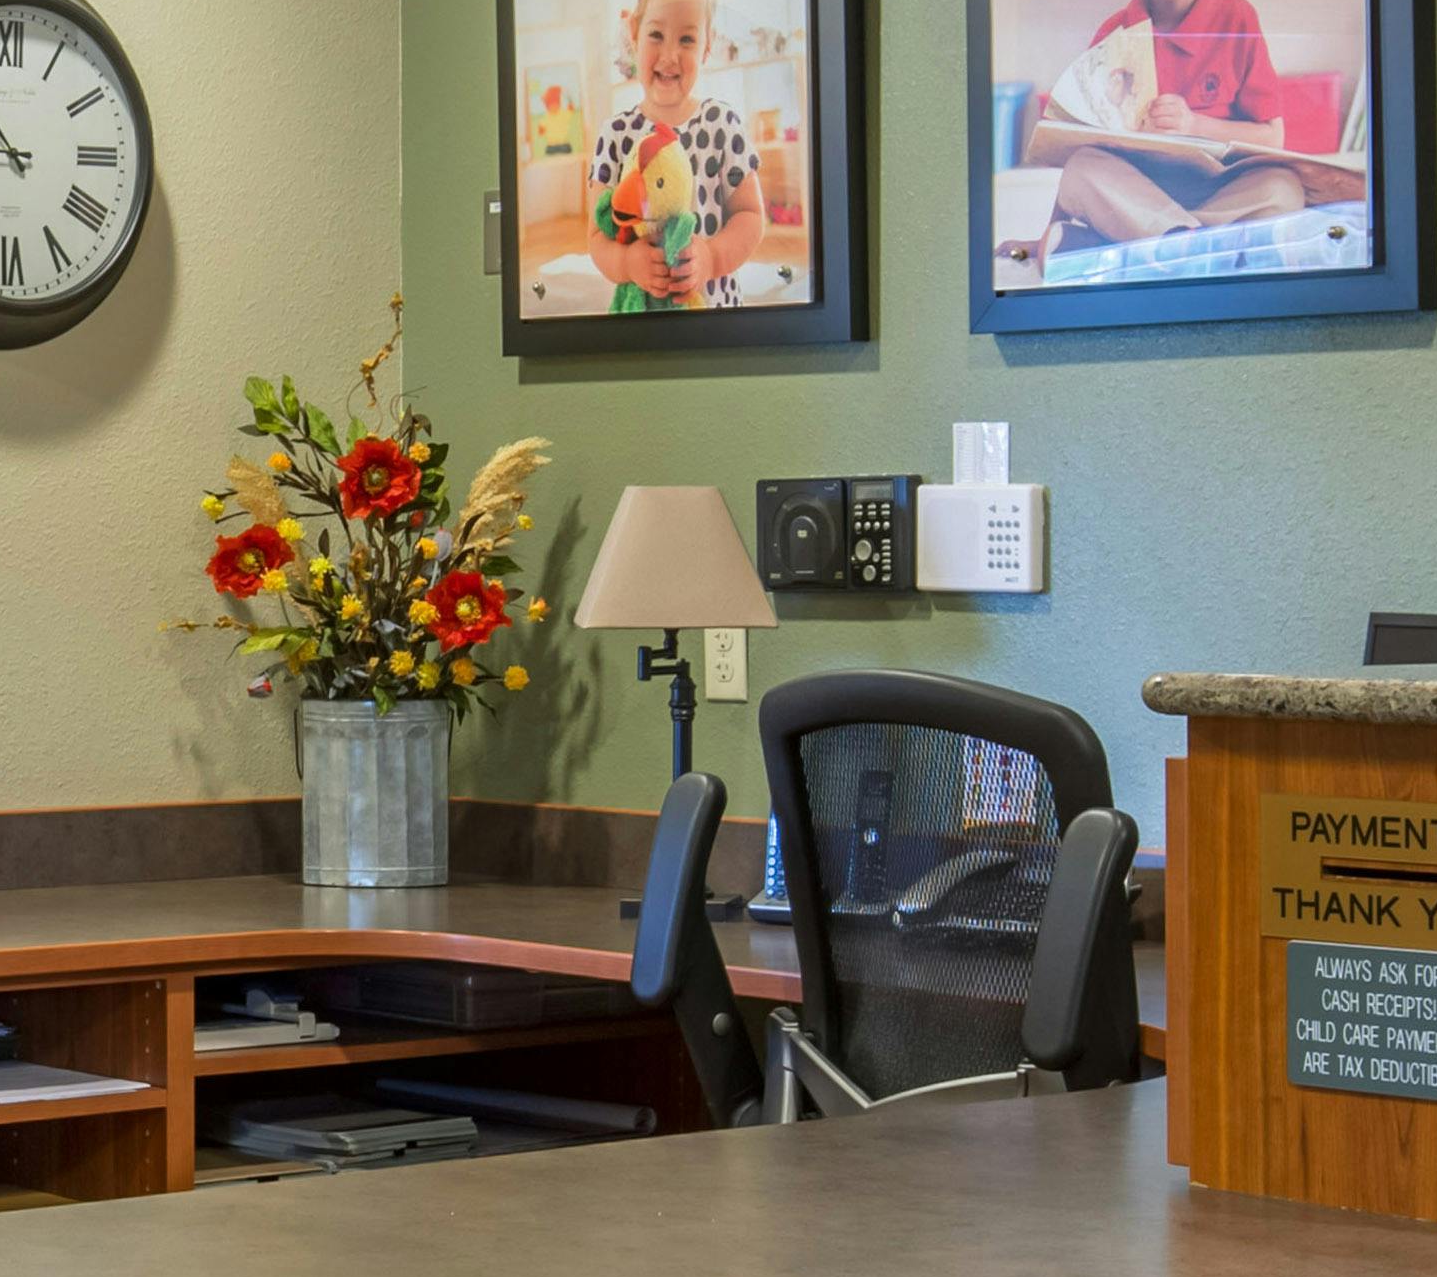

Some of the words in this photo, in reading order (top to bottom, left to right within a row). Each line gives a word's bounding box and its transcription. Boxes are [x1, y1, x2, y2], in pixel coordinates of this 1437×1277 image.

[42, 40, 66, 81] I
[66, 86, 106, 118] II
[76, 145, 118, 167] III
[62, 184, 109, 234] IIII
[1, 235, 25, 287] VI
[42, 225, 73, 274] V
[1272, 887, 1401, 928] THANK
[1315, 956, 1372, 983] ALWAYS
[1379, 961, 1408, 985] ASK
[1321, 988, 1359, 1013] CASH
[1366, 993, 1437, 1021] RECEIPTS!
[1296, 1018, 1336, 1043] CHILD
[1343, 1022, 1380, 1047] CARE
[1303, 1052, 1330, 1074] ARE
[1337, 1054, 1364, 1078] TAX
